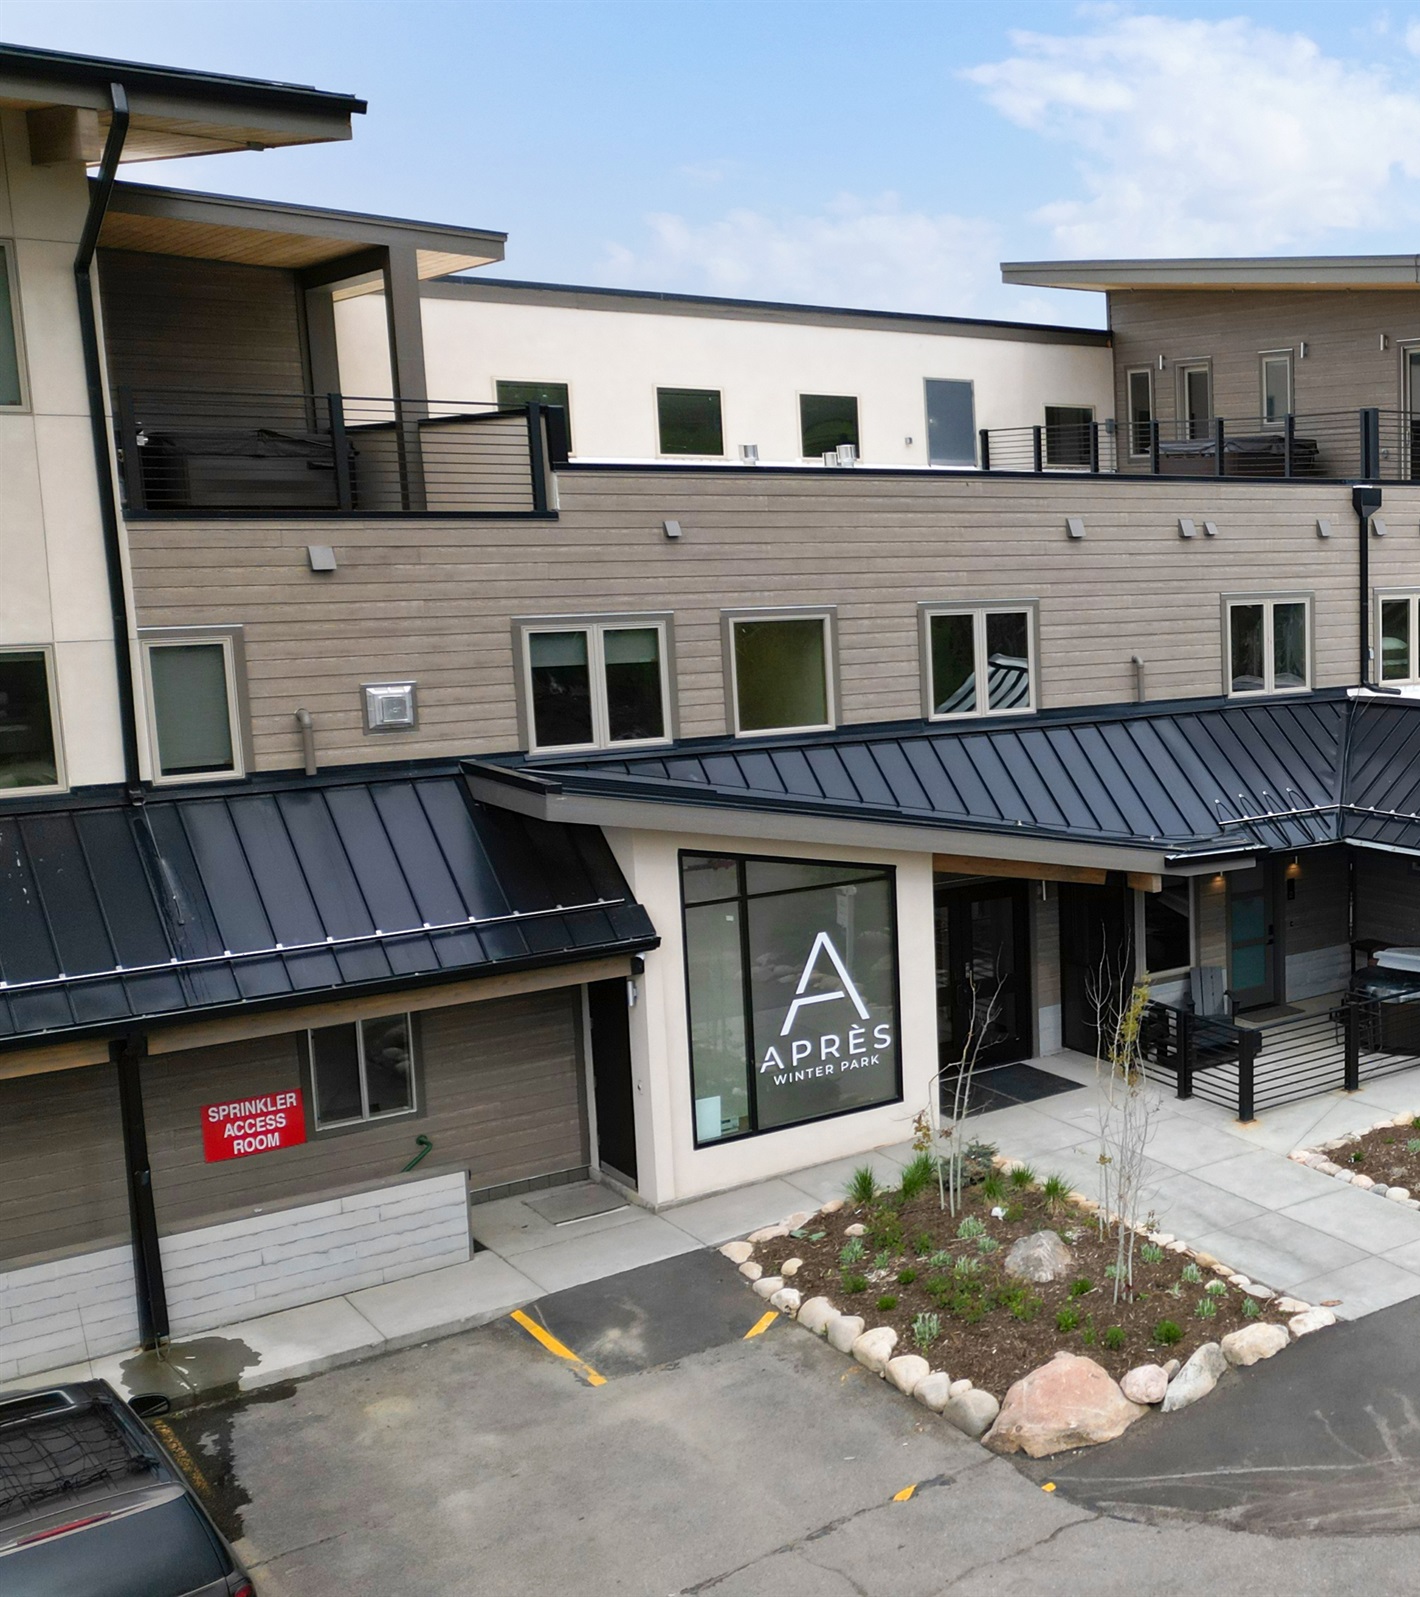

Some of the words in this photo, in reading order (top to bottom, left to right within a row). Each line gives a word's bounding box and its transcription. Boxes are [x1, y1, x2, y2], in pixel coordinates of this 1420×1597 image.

[780, 931, 870, 1036] A
[760, 1024, 892, 1073] APRÈS
[773, 1064, 834, 1086] WINTER
[841, 1054, 880, 1072] PARK
[207, 1092, 297, 1122] SPRINKLER
[223, 1112, 287, 1138] ACCESS
[233, 1132, 280, 1155] ROOM
